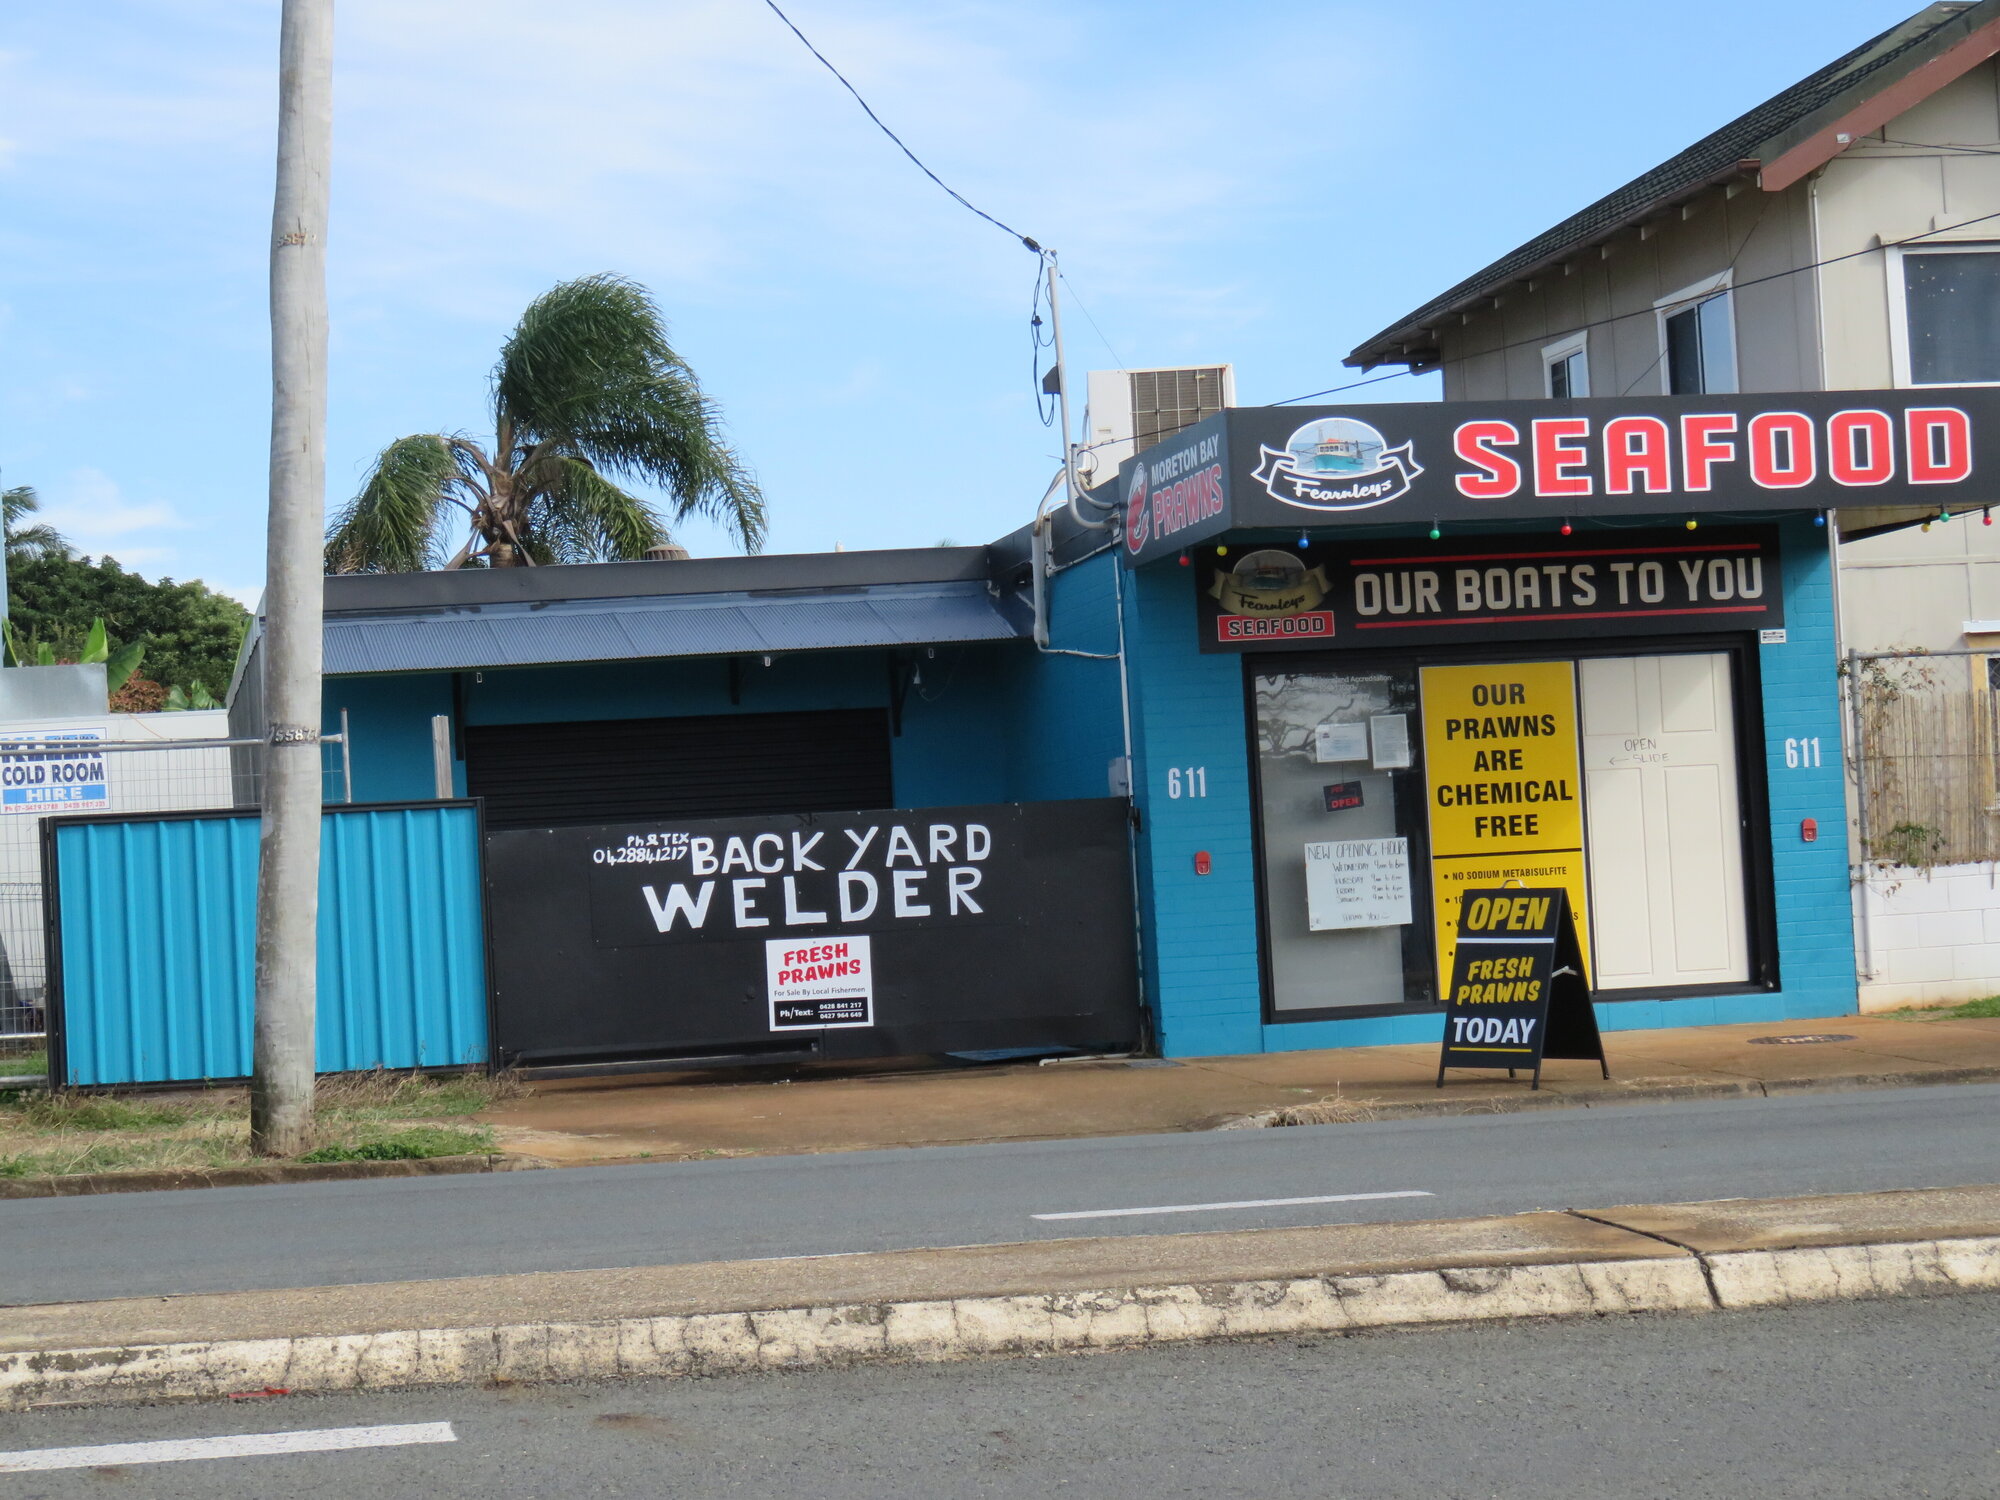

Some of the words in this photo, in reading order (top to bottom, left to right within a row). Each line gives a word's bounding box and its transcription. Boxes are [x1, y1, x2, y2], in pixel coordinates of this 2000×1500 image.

[1151, 452, 1199, 487] MORETON
[1201, 434, 1219, 463] BAY
[1453, 406, 1972, 499] SEAFOOD
[1283, 475, 1392, 501] Fearnleys
[1152, 463, 1223, 540] PRAWNS
[1354, 571, 1442, 616] OUR
[1455, 564, 1597, 612] BOATS
[1610, 561, 1665, 605] TO
[1679, 557, 1763, 601] YOU
[1232, 591, 1305, 611] Fearnleys
[1228, 617, 1326, 637] SEAFOOD
[1472, 683, 1526, 707] OUR
[1446, 714, 1556, 740] PRAWNS
[1624, 738, 1657, 752] OPEN
[1785, 737, 1821, 768] 611
[1474, 749, 1523, 772] ARE
[1633, 753, 1669, 763] SLIDE
[2, 765, 46, 786] COLD
[52, 762, 105, 783] ROOM
[1168, 766, 1206, 799] 611
[25, 787, 83, 802] HIRE
[1331, 797, 1361, 808] OPEN
[1437, 780, 1573, 807] CHEMICAL
[1475, 814, 1539, 838] FREE
[627, 835, 644, 847] Ph
[660, 832, 690, 846] TEX
[690, 831, 826, 876] BACK
[844, 824, 991, 870] YARD
[1308, 845, 1330, 860] NEW
[1336, 841, 1378, 859] OPENING
[1452, 872, 1464, 881] NO
[1466, 870, 1500, 880] SODIUM
[1502, 866, 1567, 878] METABISULFITE
[642, 866, 984, 933] WELDER
[1467, 897, 1550, 931] OPEN
[783, 942, 849, 967] FRESH
[777, 959, 861, 986] PRAWNS
[1467, 956, 1534, 982] FRESH
[786, 989, 801, 997] Sale
[802, 989, 811, 997] By
[812, 987, 830, 996] Local
[831, 986, 866, 995] Fishermen
[1456, 980, 1541, 1006] PRAWNS
[780, 1006, 814, 1020] Ph/Text:
[1453, 1017, 1536, 1044] TODAY
